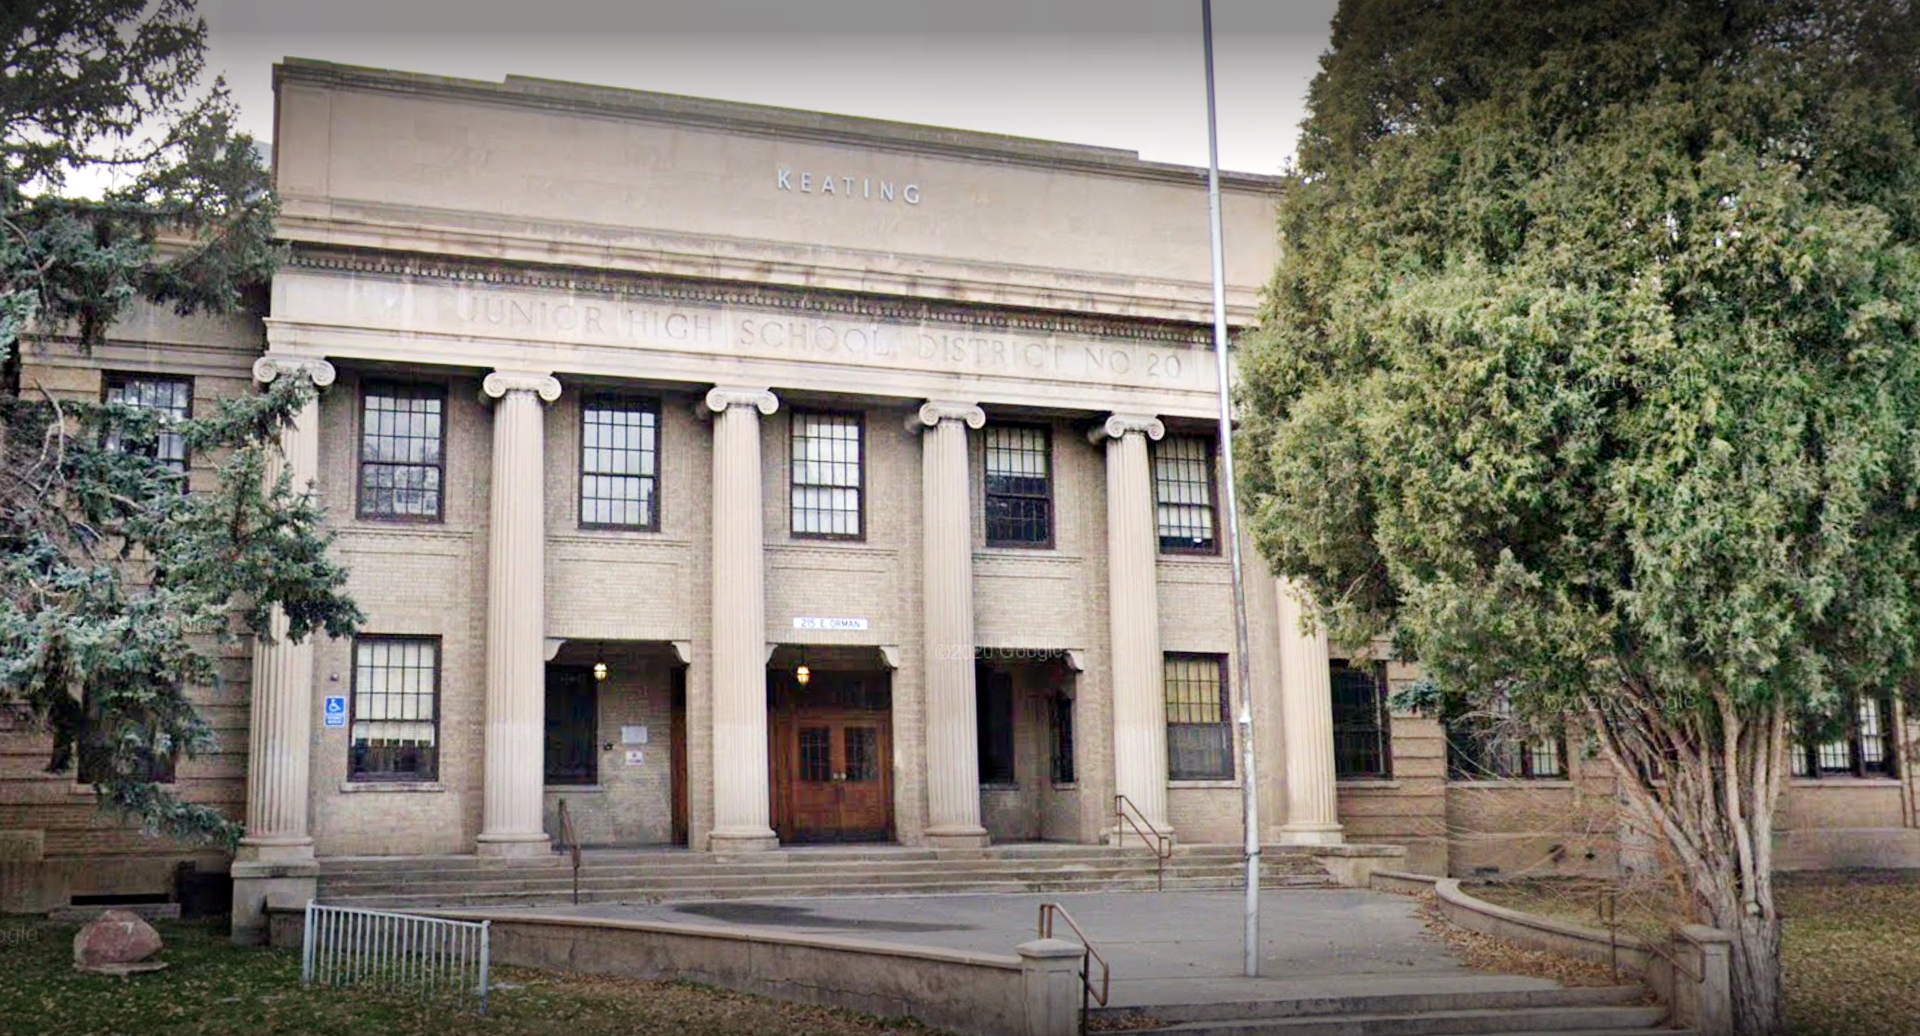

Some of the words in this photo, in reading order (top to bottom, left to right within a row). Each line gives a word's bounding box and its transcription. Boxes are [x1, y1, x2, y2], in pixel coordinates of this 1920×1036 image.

[777, 169, 920, 205] KEATING
[459, 295, 604, 336] JUNIOR
[625, 308, 712, 343] HIGH
[917, 333, 1063, 370] DISTRICT
[1147, 352, 1182, 378] 20
[801, 618, 816, 628] 215
[820, 618, 826, 628] E
[829, 619, 861, 628] ORMAN
